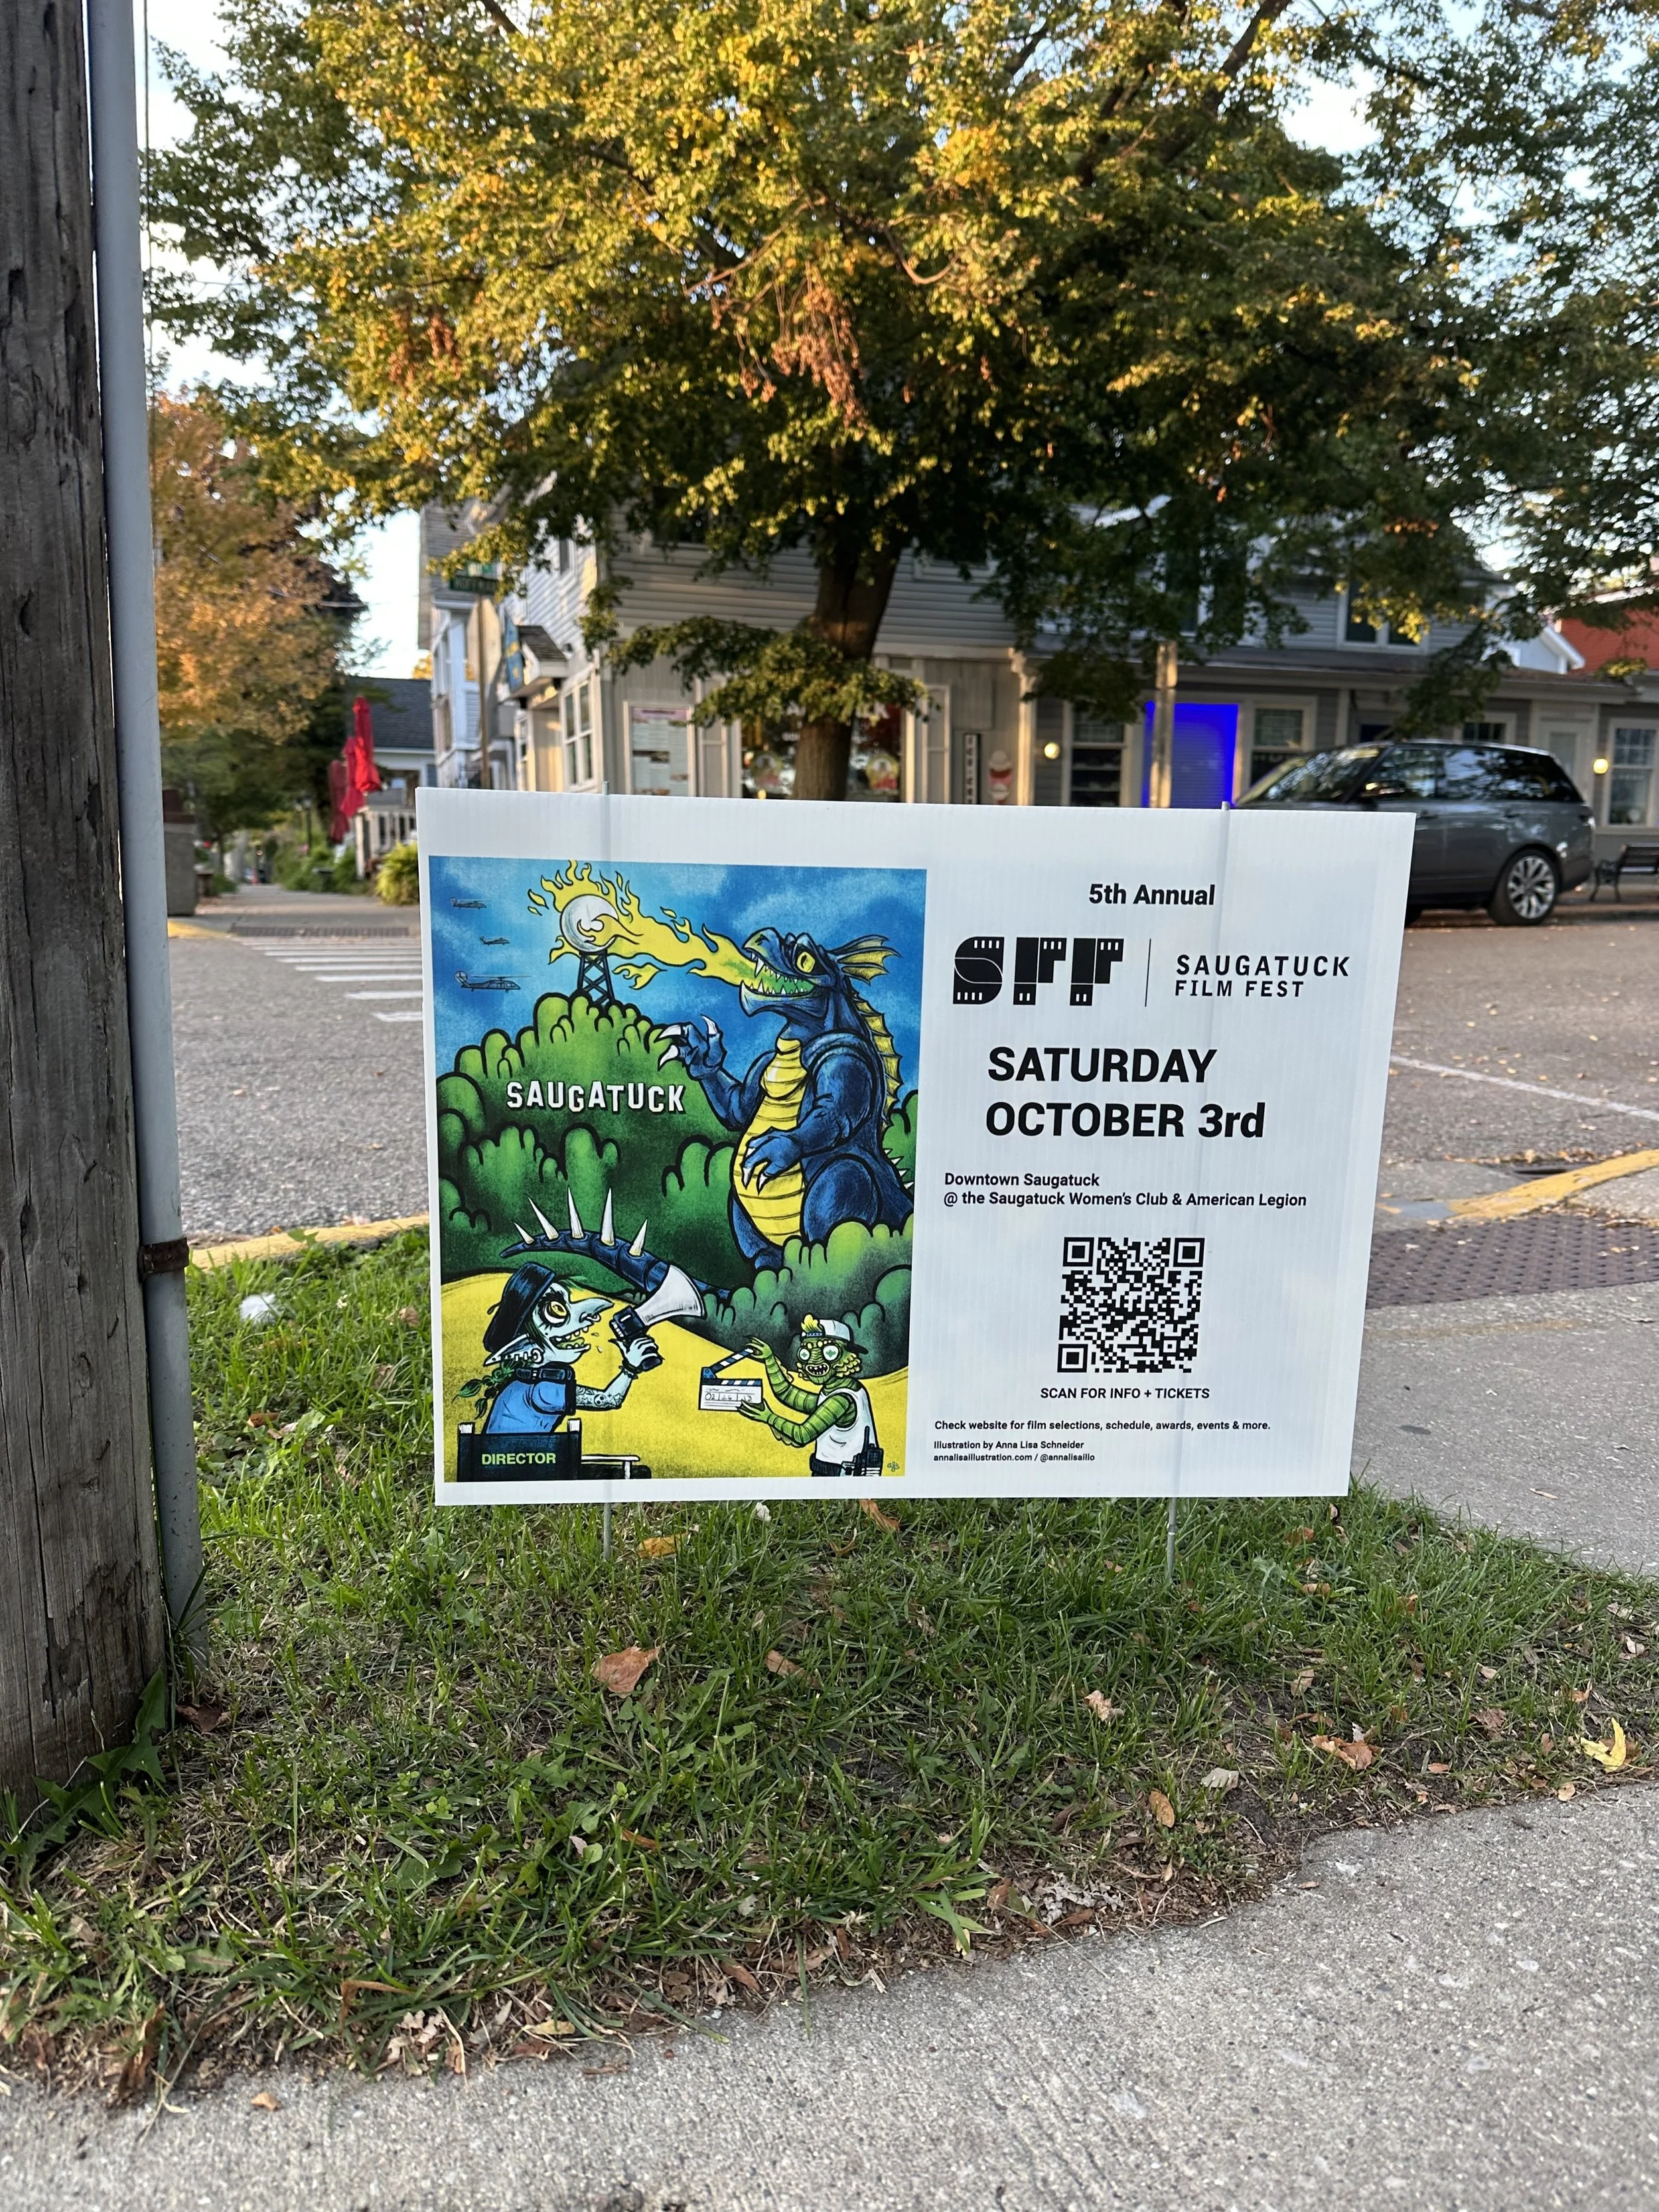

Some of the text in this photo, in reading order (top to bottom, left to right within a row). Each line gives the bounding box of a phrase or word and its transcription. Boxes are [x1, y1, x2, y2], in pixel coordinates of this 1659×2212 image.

[1089, 883, 1216, 905] 5th Annual
[952, 936, 1124, 1007] SFF
[1176, 954, 1350, 977] SAUGATUCK
[1175, 980, 1304, 997] FILM FEST
[987, 1046, 1218, 1083] SATURDAY
[506, 1080, 685, 1113] SAUGATUCK
[986, 1101, 1265, 1138] OCTOBER 3rd
[944, 1172, 1100, 1189] Downtown Saugatuck
[944, 1191, 958, 1207] @
[962, 1191, 985, 1205] the
[989, 1191, 1065, 1208] Saugatuck
[1135, 1192, 1168, 1205] Club
[1172, 1193, 1183, 1206] &
[1185, 1193, 1255, 1206] American
[1259, 1193, 1307, 1209] Legion
[1040, 1387, 1210, 1399] SCAN FOR INFO + TICKETS
[934, 1420, 966, 1430] Check
[968, 1420, 1008, 1430] website
[1010, 1420, 1025, 1430] for
[1027, 1420, 1046, 1430] film
[1049, 1420, 1103, 1431] selections,
[1106, 1420, 1153, 1432] schedule,
[1155, 1420, 1194, 1432] awards,
[1196, 1421, 1230, 1430] events
[1232, 1420, 1240, 1430] &
[934, 1440, 981, 1449] Illustration
[983, 1440, 993, 1451] by
[1020, 1440, 1038, 1449] Lisa
[1040, 1440, 1084, 1449] Schneider
[481, 1452, 557, 1465] DIRECTOR
[933, 1453, 1033, 1461] annalisaillustration.com
